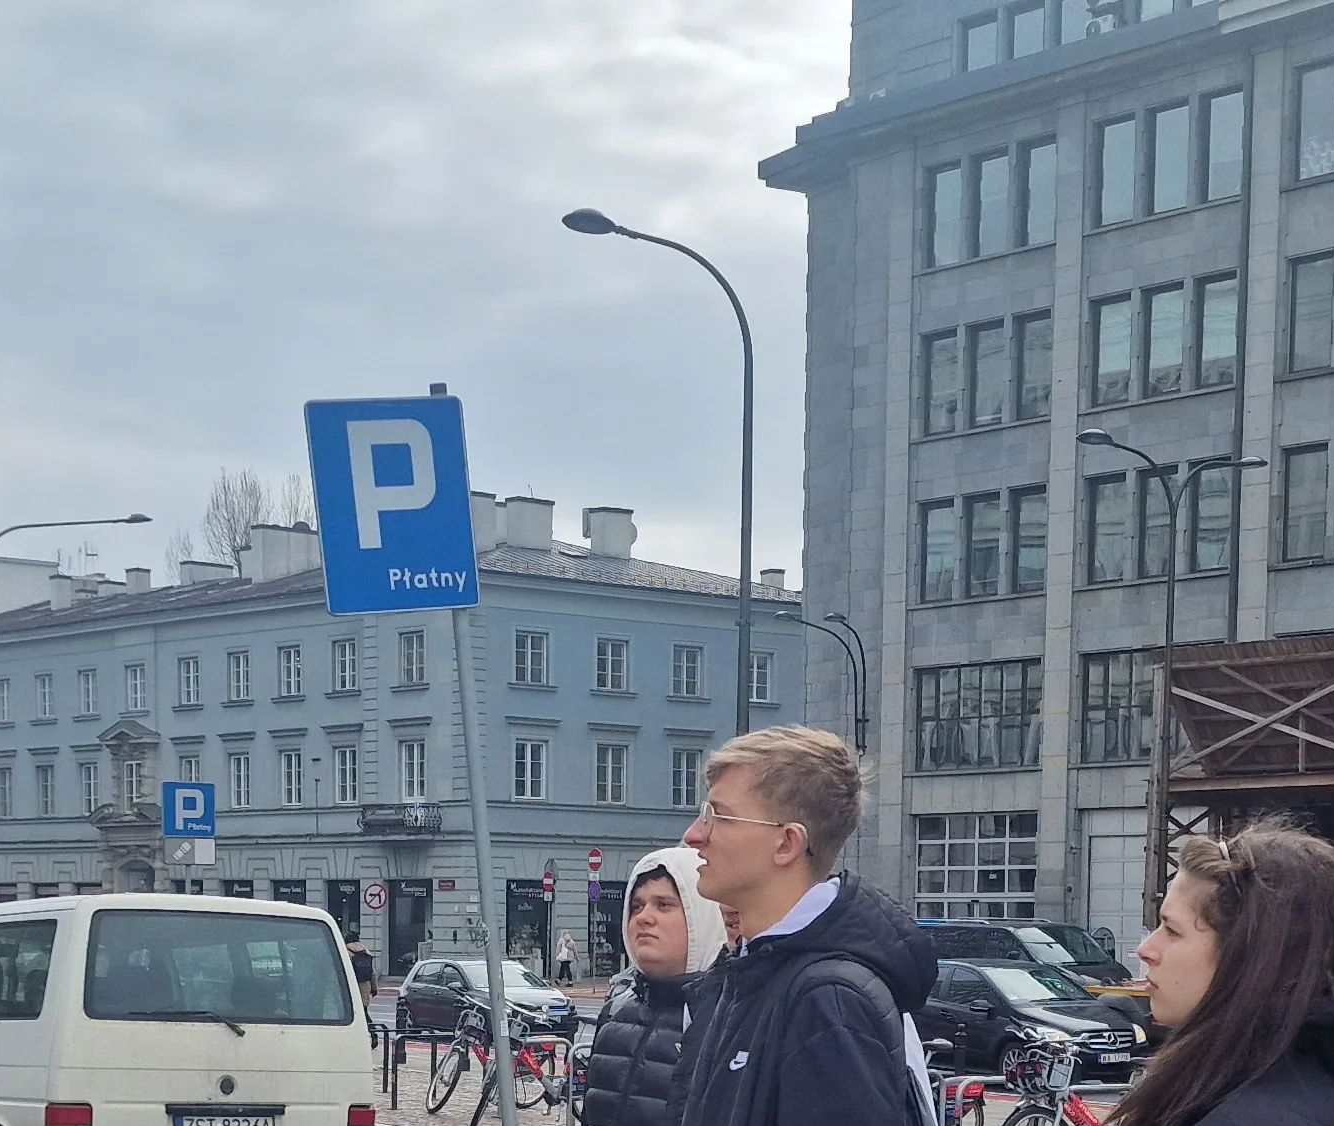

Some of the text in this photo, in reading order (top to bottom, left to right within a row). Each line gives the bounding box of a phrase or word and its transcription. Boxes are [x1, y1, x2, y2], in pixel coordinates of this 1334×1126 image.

[346, 418, 436, 550] P
[388, 567, 468, 593] Płatny
[175, 788, 205, 830] P
